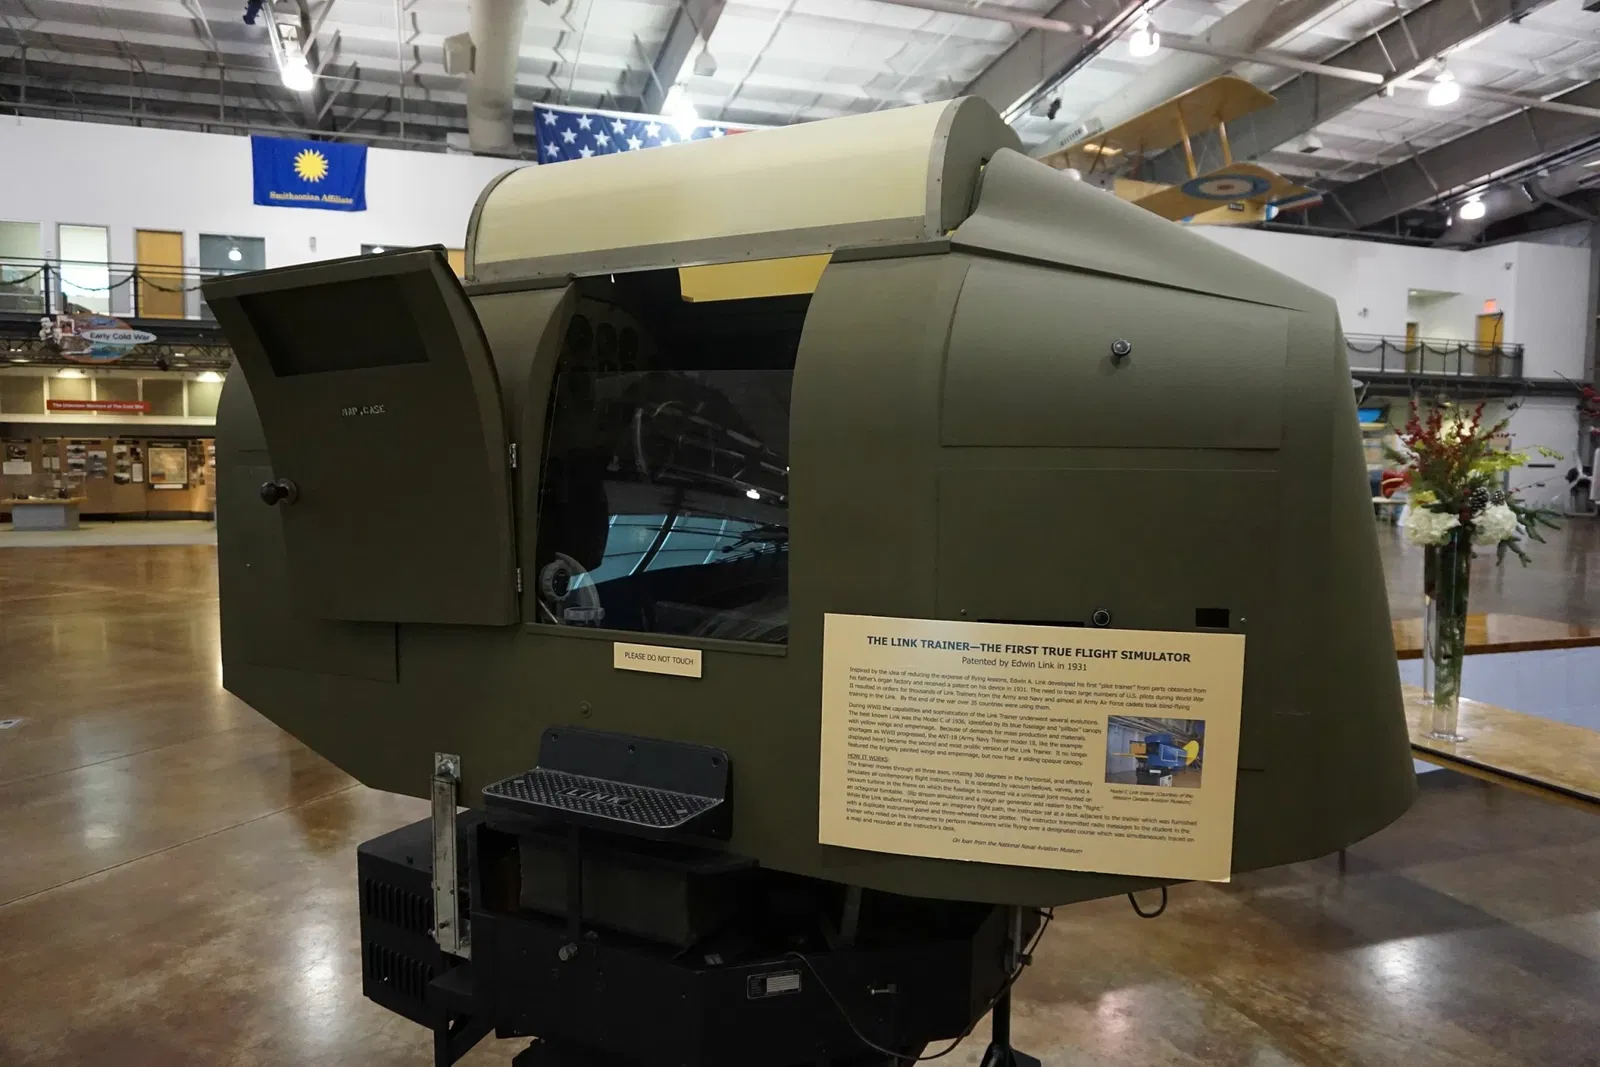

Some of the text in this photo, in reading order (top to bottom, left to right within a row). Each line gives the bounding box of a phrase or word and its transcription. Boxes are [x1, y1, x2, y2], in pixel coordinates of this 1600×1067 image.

[270, 191, 354, 204] Smithsonian Affiliate
[90, 332, 110, 341] Early
[112, 332, 132, 340] Cold
[866, 636, 887, 645] THE
[891, 637, 917, 647] LINK
[1005, 644, 1037, 654] FIRST
[1042, 646, 1071, 656] TRUE
[1075, 648, 1116, 658] FLIGHT
[1120, 650, 1190, 662] SIMULATOR
[624, 652, 646, 661] PLEASE
[646, 654, 656, 662] DO
[672, 656, 694, 665] TOUCH
[961, 656, 1087, 670] Patented by Edwin Link in 1931
[566, 788, 628, 804] LINK
